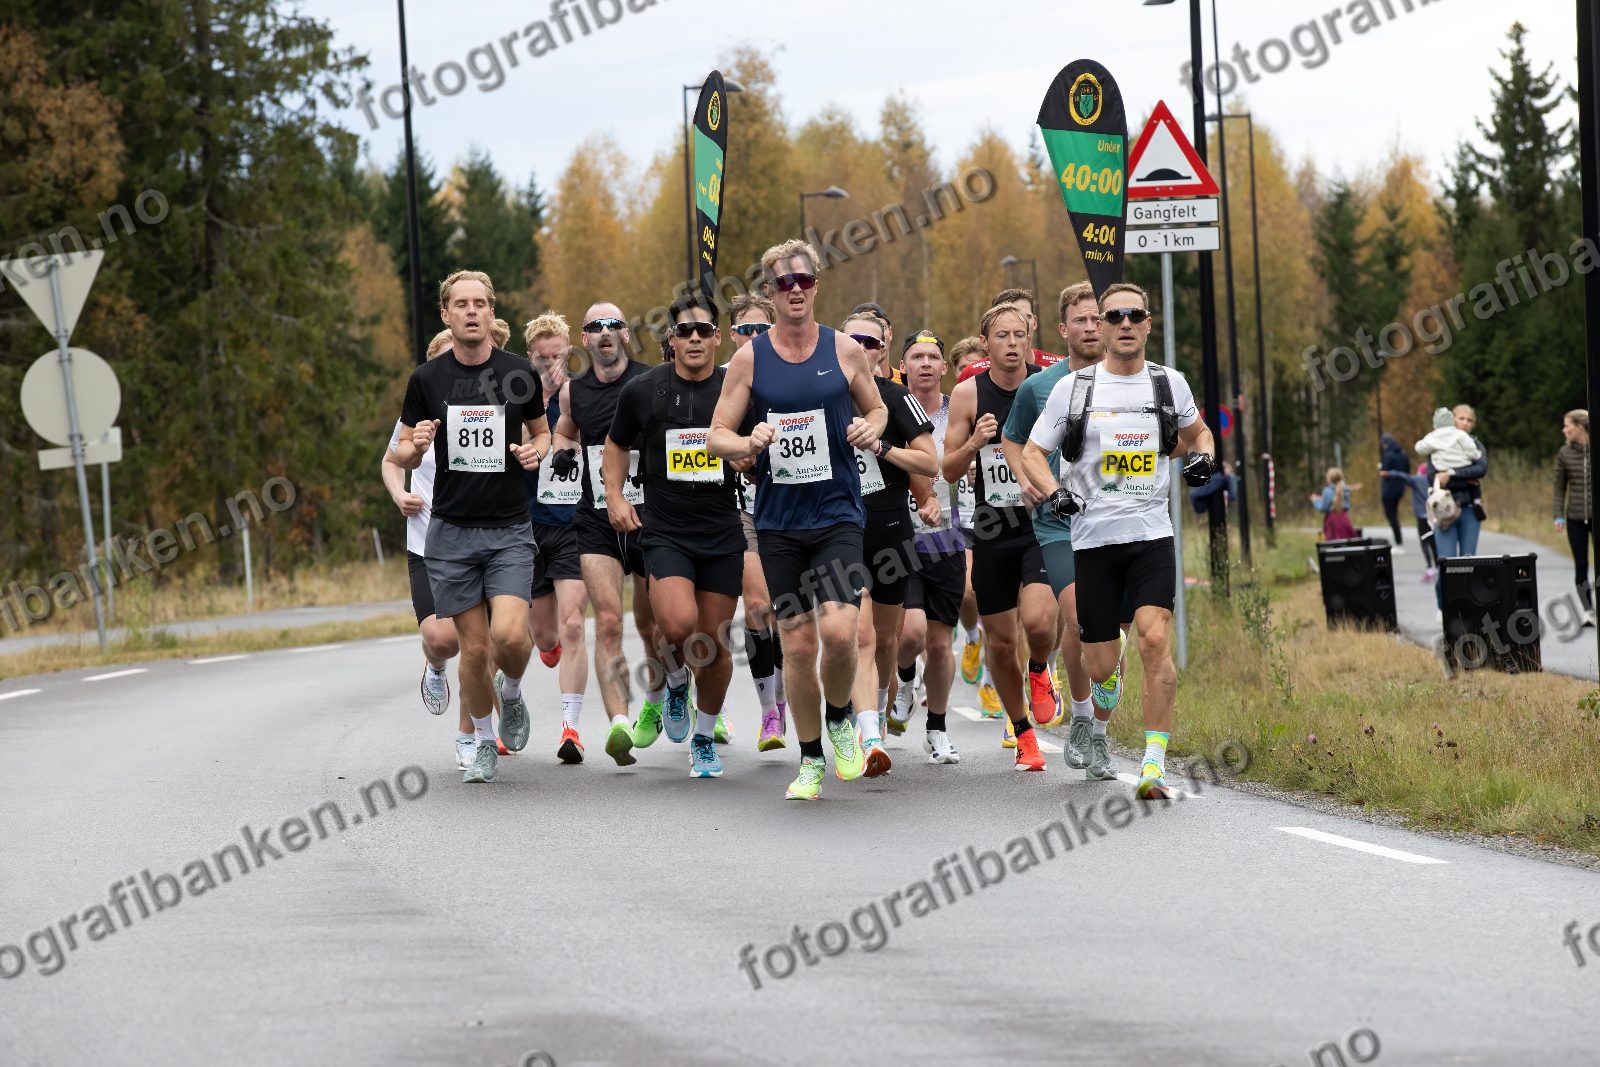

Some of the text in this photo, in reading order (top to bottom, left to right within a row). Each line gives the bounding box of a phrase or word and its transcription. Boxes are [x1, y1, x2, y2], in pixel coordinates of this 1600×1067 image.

[1097, 139, 1121, 154] Under
[1060, 162, 1122, 196] 40:00
[1133, 205, 1197, 221] Gangfelt
[1173, 233, 1195, 247] km
[778, 415, 815, 426] NORGES
[782, 423, 810, 433] LØPET
[458, 427, 494, 448] 818
[678, 432, 708, 440] NORGE
[1117, 439, 1145, 447] LØPET
[779, 434, 817, 459] 384
[672, 451, 718, 469] PACE
[855, 454, 867, 474] 6
[1105, 454, 1153, 473] PACE
